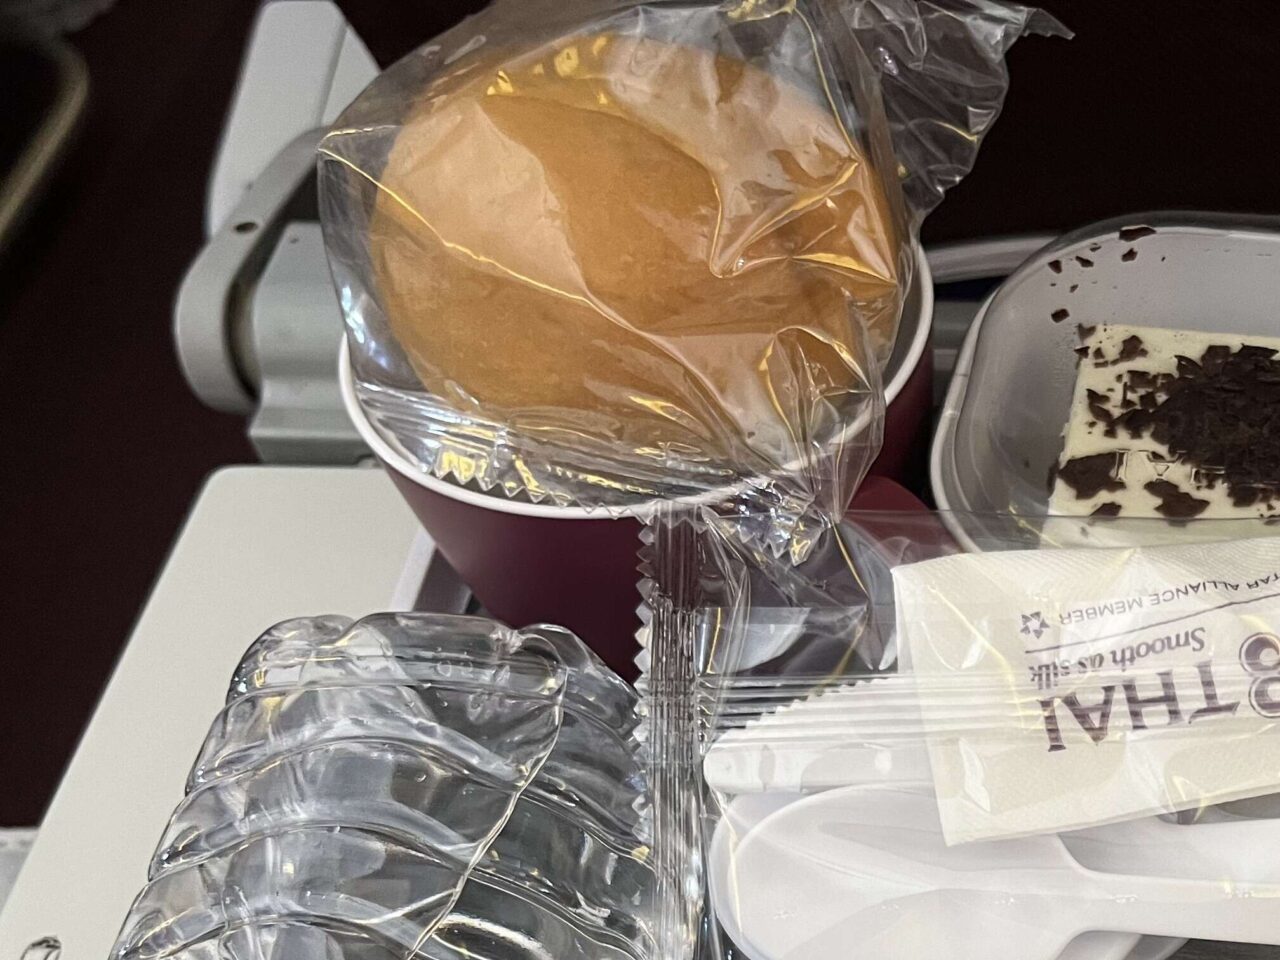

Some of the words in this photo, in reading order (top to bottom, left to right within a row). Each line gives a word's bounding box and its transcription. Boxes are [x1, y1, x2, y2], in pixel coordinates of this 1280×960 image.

[1150, 580, 1240, 605] ALLIANCE
[1058, 597, 1144, 626] MEMBER
[1111, 627, 1206, 673] Smooth
[1029, 662, 1071, 691] silk
[1078, 655, 1105, 677] as
[1036, 658, 1241, 753] THAI
